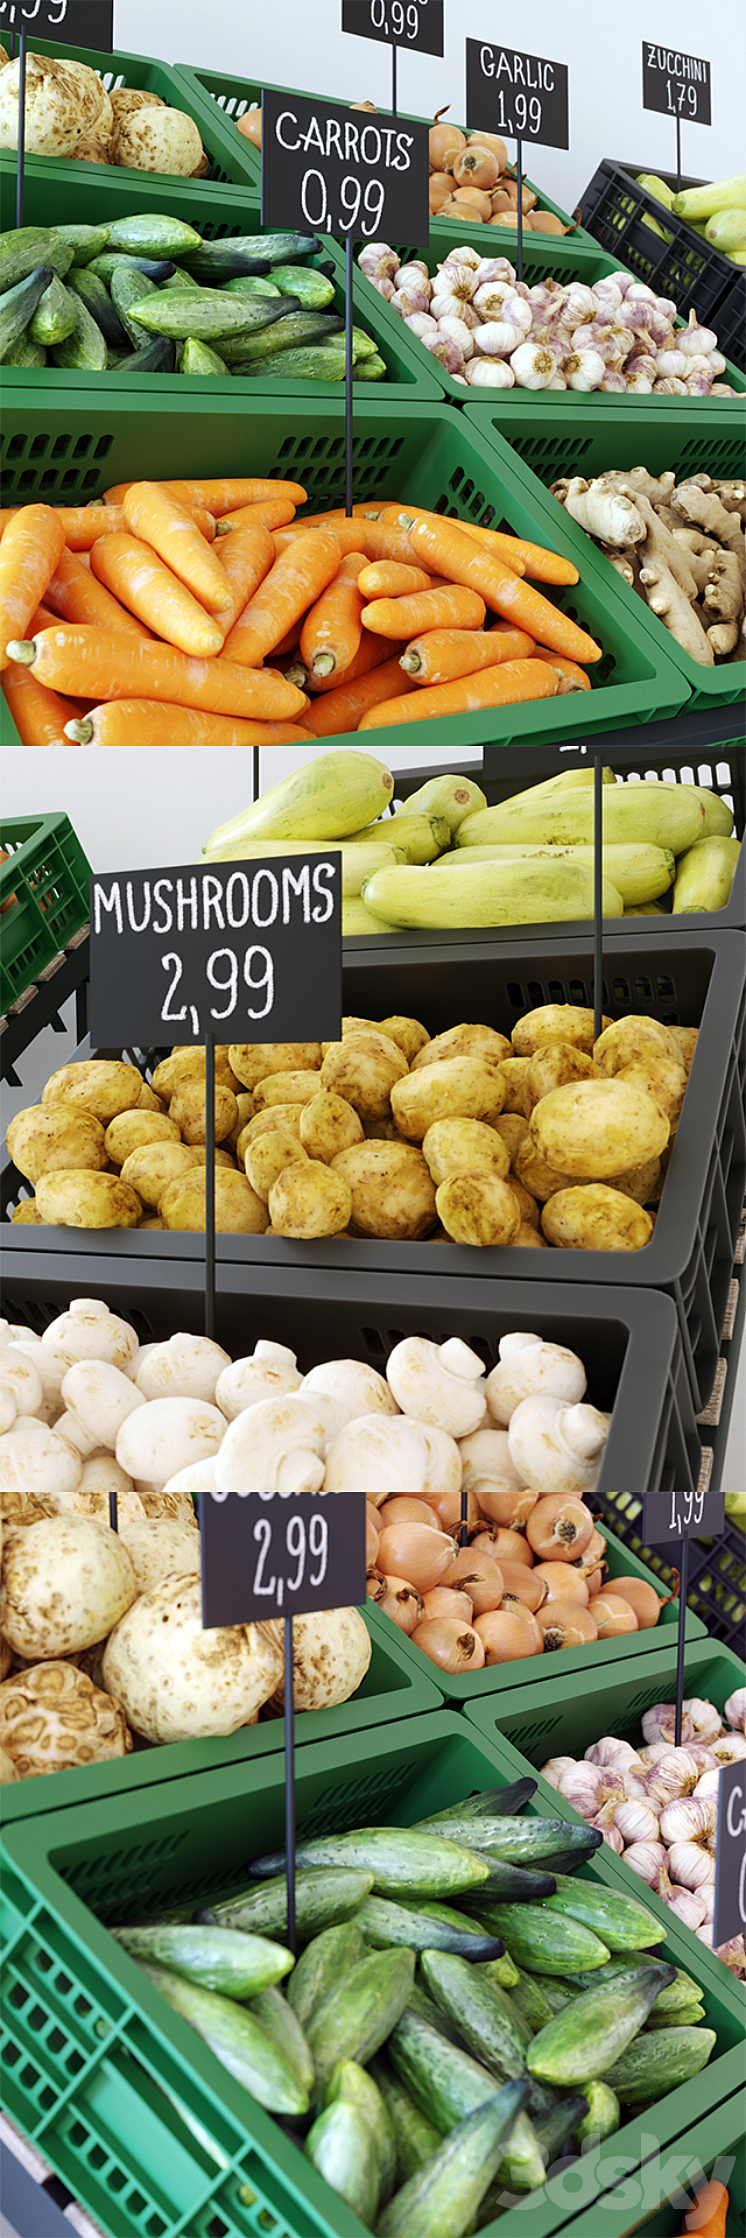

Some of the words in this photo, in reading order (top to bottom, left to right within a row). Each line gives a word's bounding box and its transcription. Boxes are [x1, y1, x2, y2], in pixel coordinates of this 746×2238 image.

[371, 0, 419, 39] 0,99
[480, 46, 554, 91] GARLIC
[647, 45, 706, 83] ZUCCHINI
[498, 90, 541, 134] 1,99
[666, 80, 697, 116] 1,79
[276, 112, 414, 171] CARROTS
[301, 169, 385, 236] 0,99
[94, 863, 336, 934] MUSHROOMS
[161, 945, 275, 1035] 2,99
[669, 1492, 705, 1535] 1,99
[253, 1514, 328, 1606] 2,99
